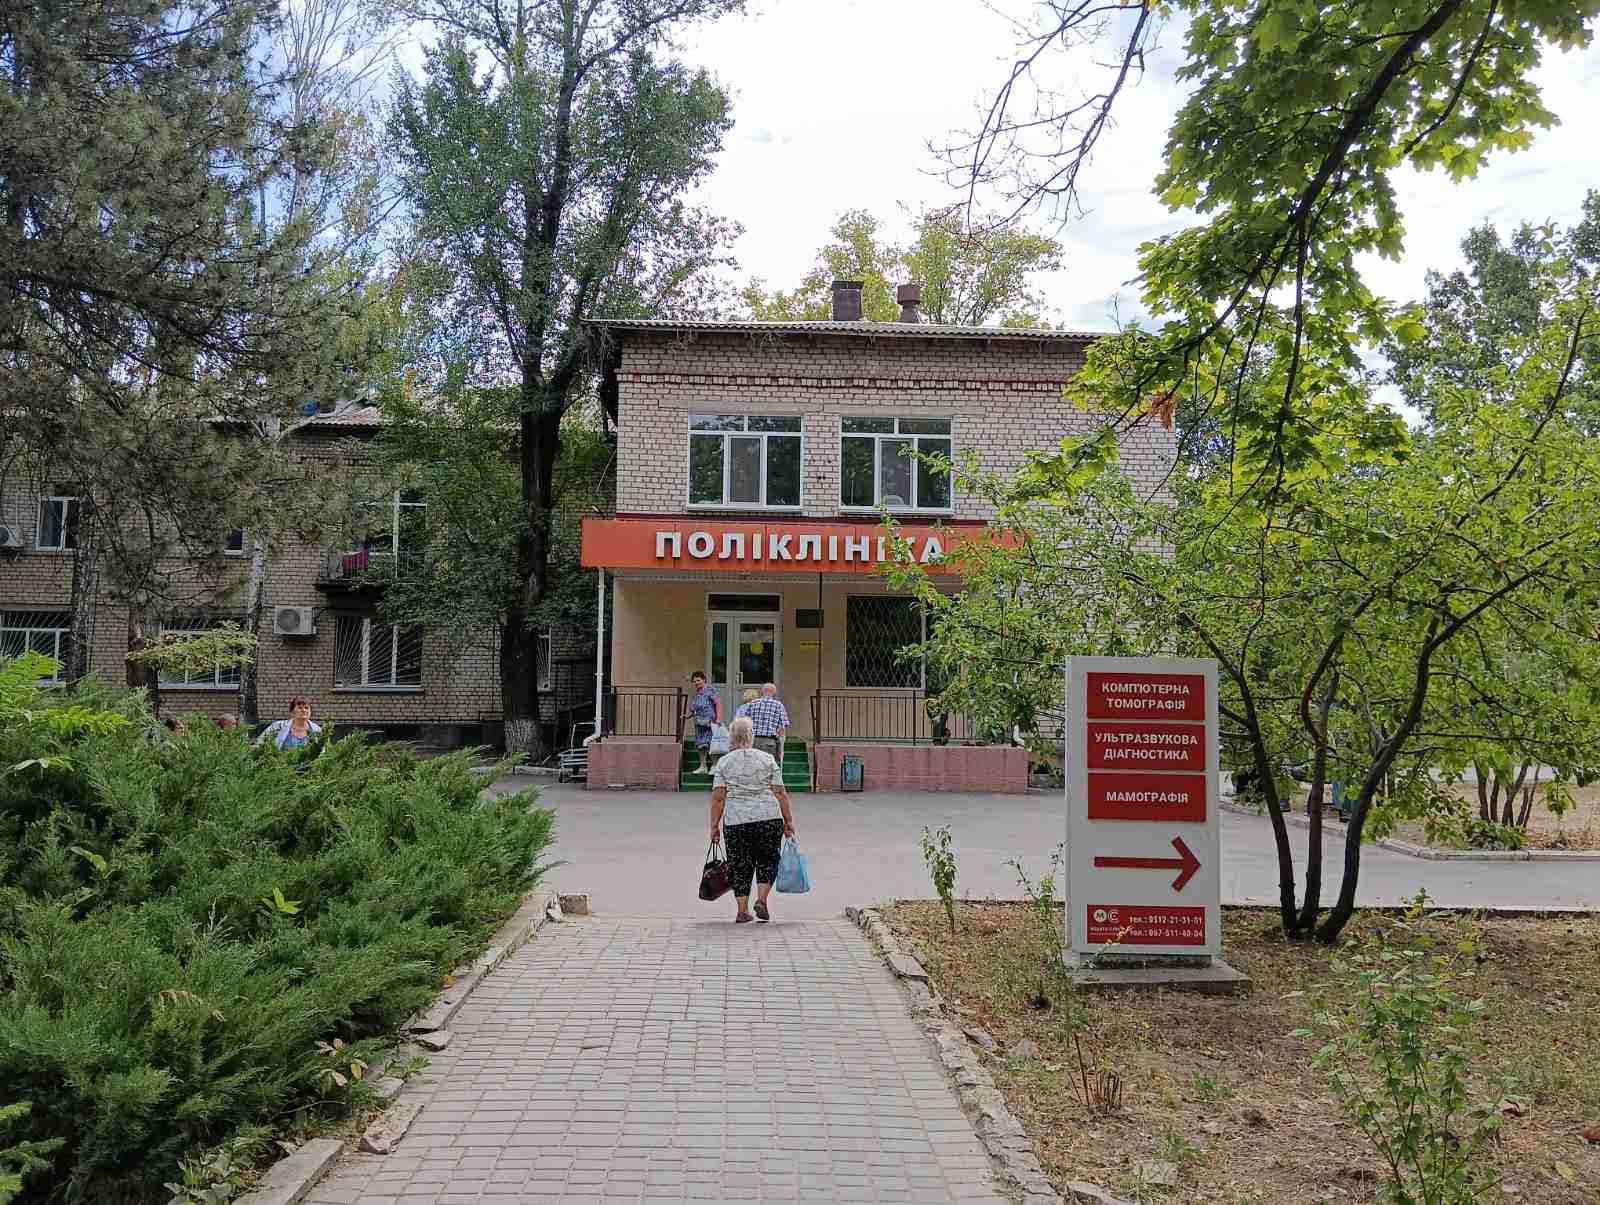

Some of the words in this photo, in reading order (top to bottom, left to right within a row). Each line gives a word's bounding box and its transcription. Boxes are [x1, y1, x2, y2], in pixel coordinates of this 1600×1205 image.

[1101, 682, 1190, 695] КОМП'ЮТЕРНА
[1106, 698, 1186, 710] ТОМОГРАФІЯ
[1094, 733, 1198, 745] УЛЬТРАЗВУКОВА
[1103, 748, 1190, 761] ДІАГНОСТИКА
[1105, 791, 1189, 804] МАМОГРАФІЯ
